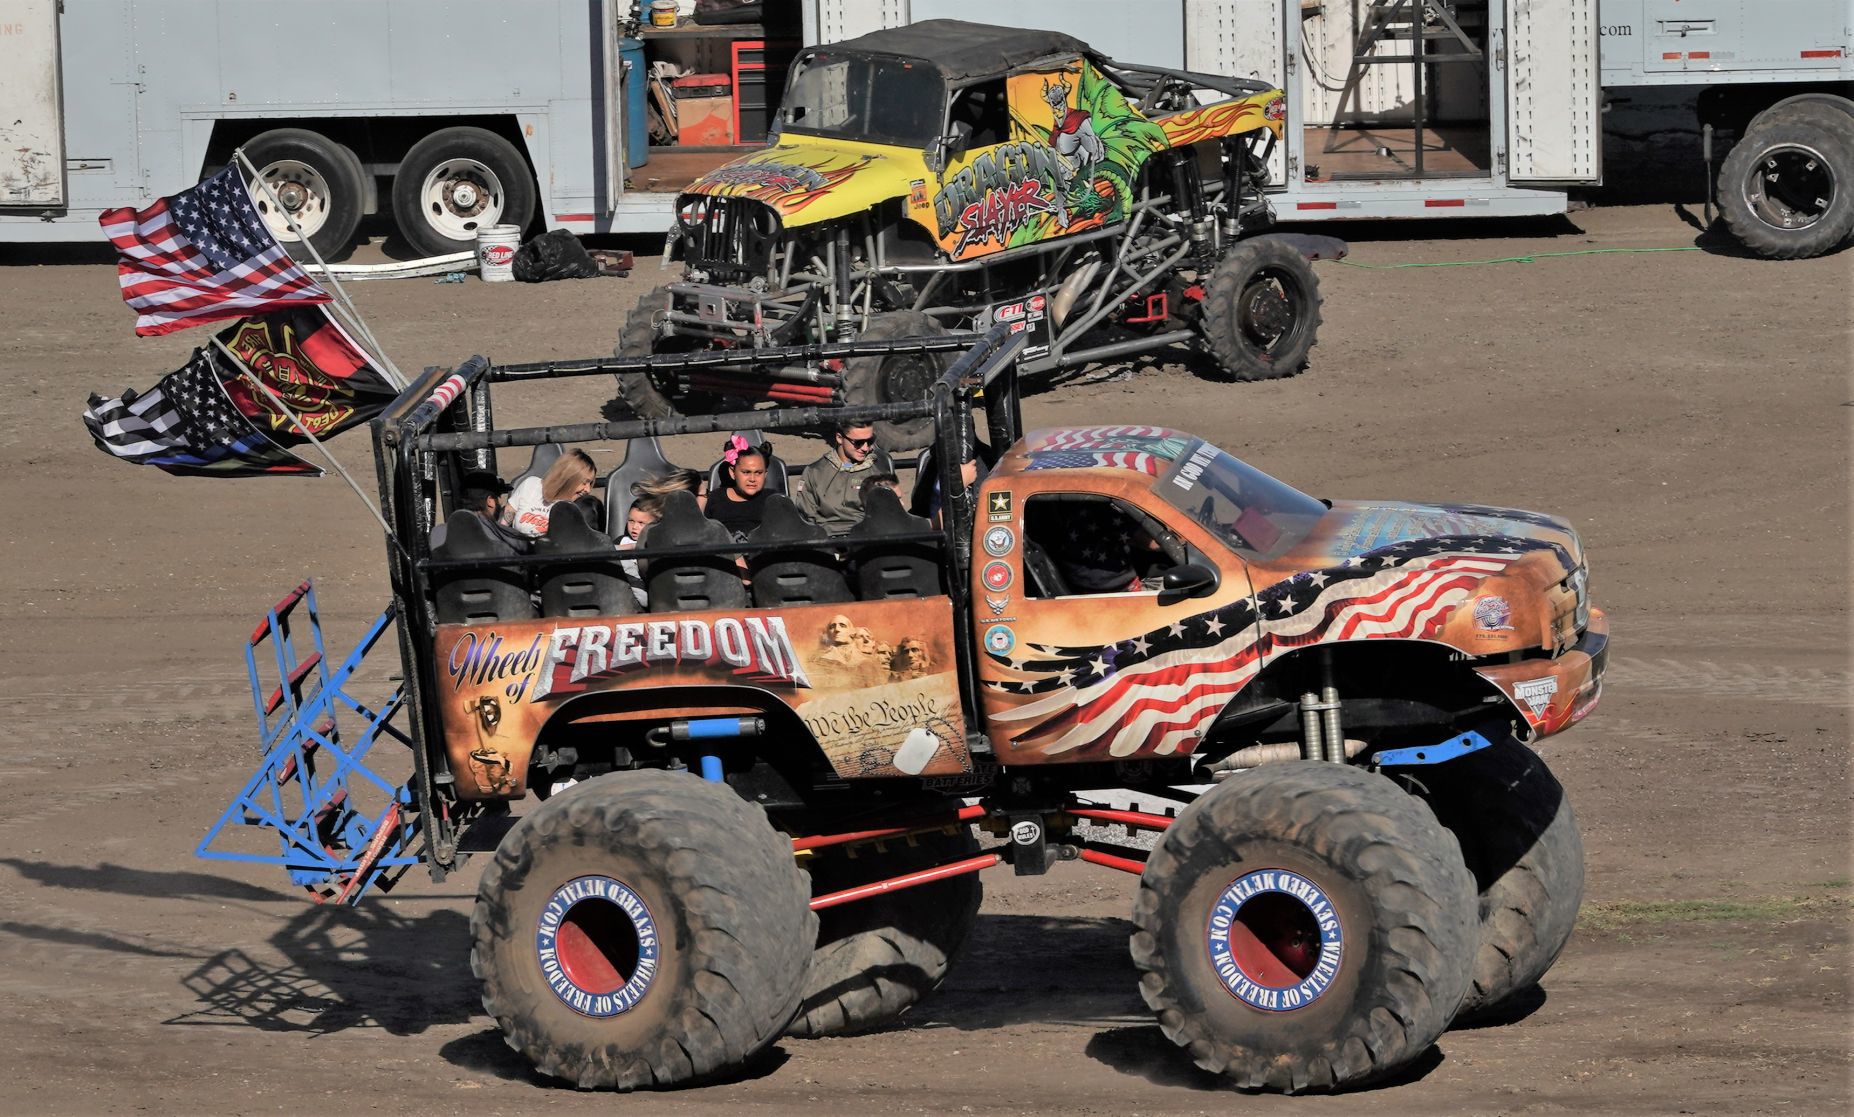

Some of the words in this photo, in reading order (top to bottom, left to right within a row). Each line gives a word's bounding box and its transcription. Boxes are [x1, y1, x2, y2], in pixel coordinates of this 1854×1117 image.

[934, 141, 1066, 240] DRAGON
[954, 177, 1057, 258] SLAYER
[1000, 303, 1023, 318] FTI
[449, 631, 544, 693] Wheels
[505, 672, 535, 704] of
[531, 616, 812, 703] FREEDOM
[804, 714, 841, 738] We
[870, 693, 938, 727] People
[926, 775, 992, 788] BATTERIES
[607, 884, 656, 948] SEVERED
[1279, 874, 1338, 932] SEVERED
[540, 948, 593, 1012] FREEDOM
[612, 958, 656, 1010] WHEELS
[1214, 951, 1278, 1008] FREEDOM
[1282, 988, 1301, 1008] OF
[1300, 942, 1340, 1000] WHEELS
[595, 995, 612, 1013] OF
